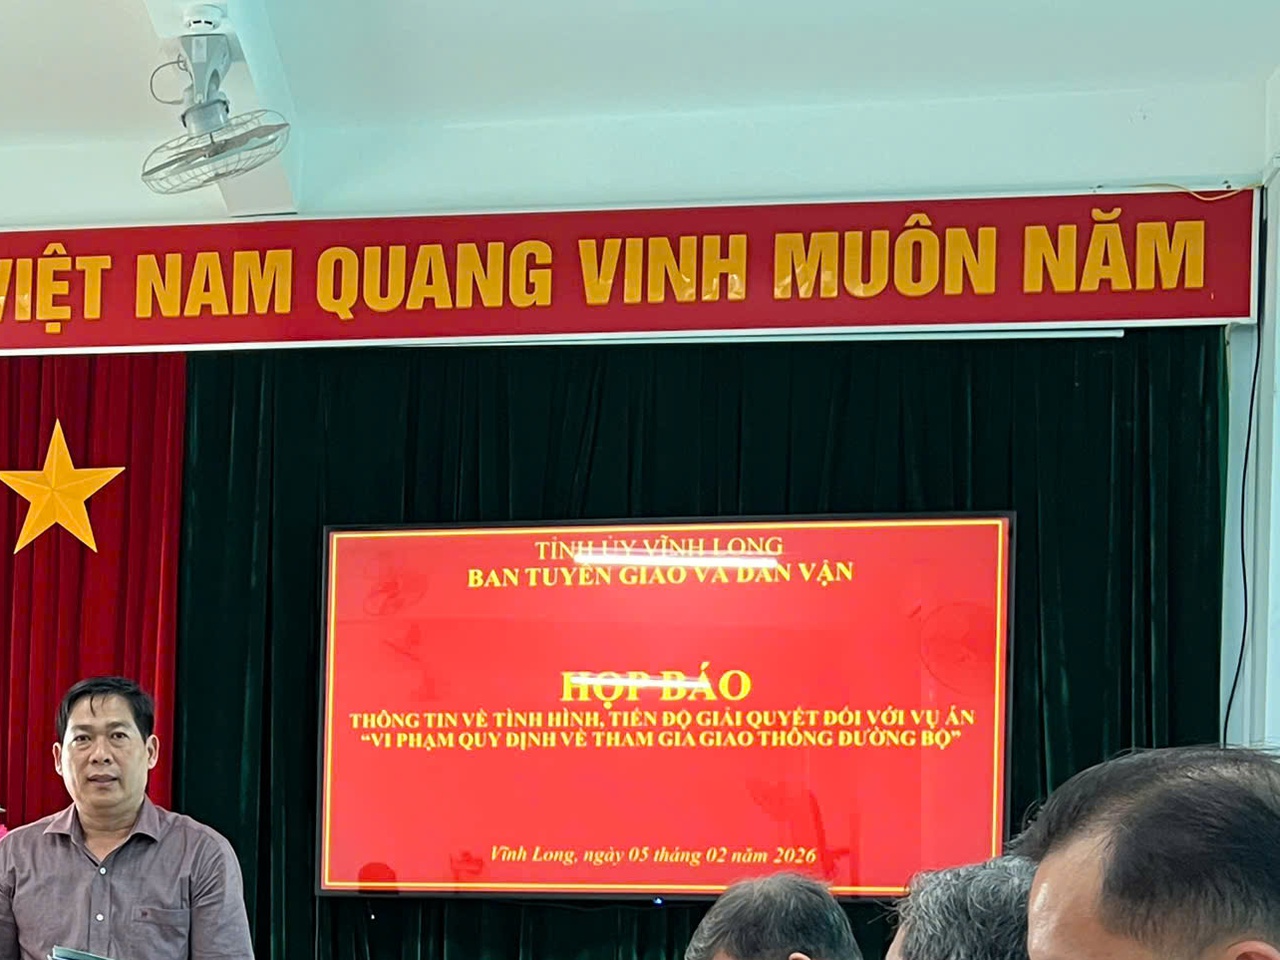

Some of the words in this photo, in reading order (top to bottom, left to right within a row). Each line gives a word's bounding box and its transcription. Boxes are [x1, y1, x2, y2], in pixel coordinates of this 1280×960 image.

[135, 248, 293, 319] NAM
[316, 239, 553, 321] QUANG
[577, 234, 747, 306] VINH
[773, 213, 997, 300] MUÔN
[1022, 207, 1205, 294] NĂM
[467, 568, 519, 588] BAN
[619, 565, 688, 586] GIAO
[798, 559, 853, 587] VẬN
[561, 671, 652, 710] HỌP
[659, 661, 752, 701] BÁO
[349, 709, 420, 729] THÔNG
[423, 712, 458, 728] TIN
[462, 708, 488, 728] VỀ
[493, 708, 543, 728] TÌNH
[547, 707, 605, 729] HÌNH,
[608, 706, 657, 727] TIẾN
[662, 708, 692, 730] ĐỘ
[696, 706, 742, 727] GIẢI
[746, 706, 819, 729] QUYẾT
[823, 705, 861, 726] ĐỐI
[866, 705, 905, 726] VỚI
[911, 709, 940, 730] VỤ
[945, 705, 975, 725] ÁN
[396, 732, 454, 751] PHẠM
[458, 731, 501, 750] QUY
[506, 731, 556, 751] ĐỊNH
[560, 728, 587, 747] VỀ
[592, 731, 654, 747] THAM
[658, 730, 696, 747] GIA
[699, 730, 754, 747] GIAO
[757, 726, 833, 746] THÔNG
[838, 725, 916, 746] ĐƯỜNG
[490, 845, 526, 862] Vĩnh
[532, 846, 578, 865] Long,
[583, 846, 624, 866] ngày
[628, 846, 649, 862] 05
[653, 846, 701, 866] tháng
[706, 847, 727, 863] 02
[731, 847, 768, 863] năm
[773, 847, 816, 864] 2026
